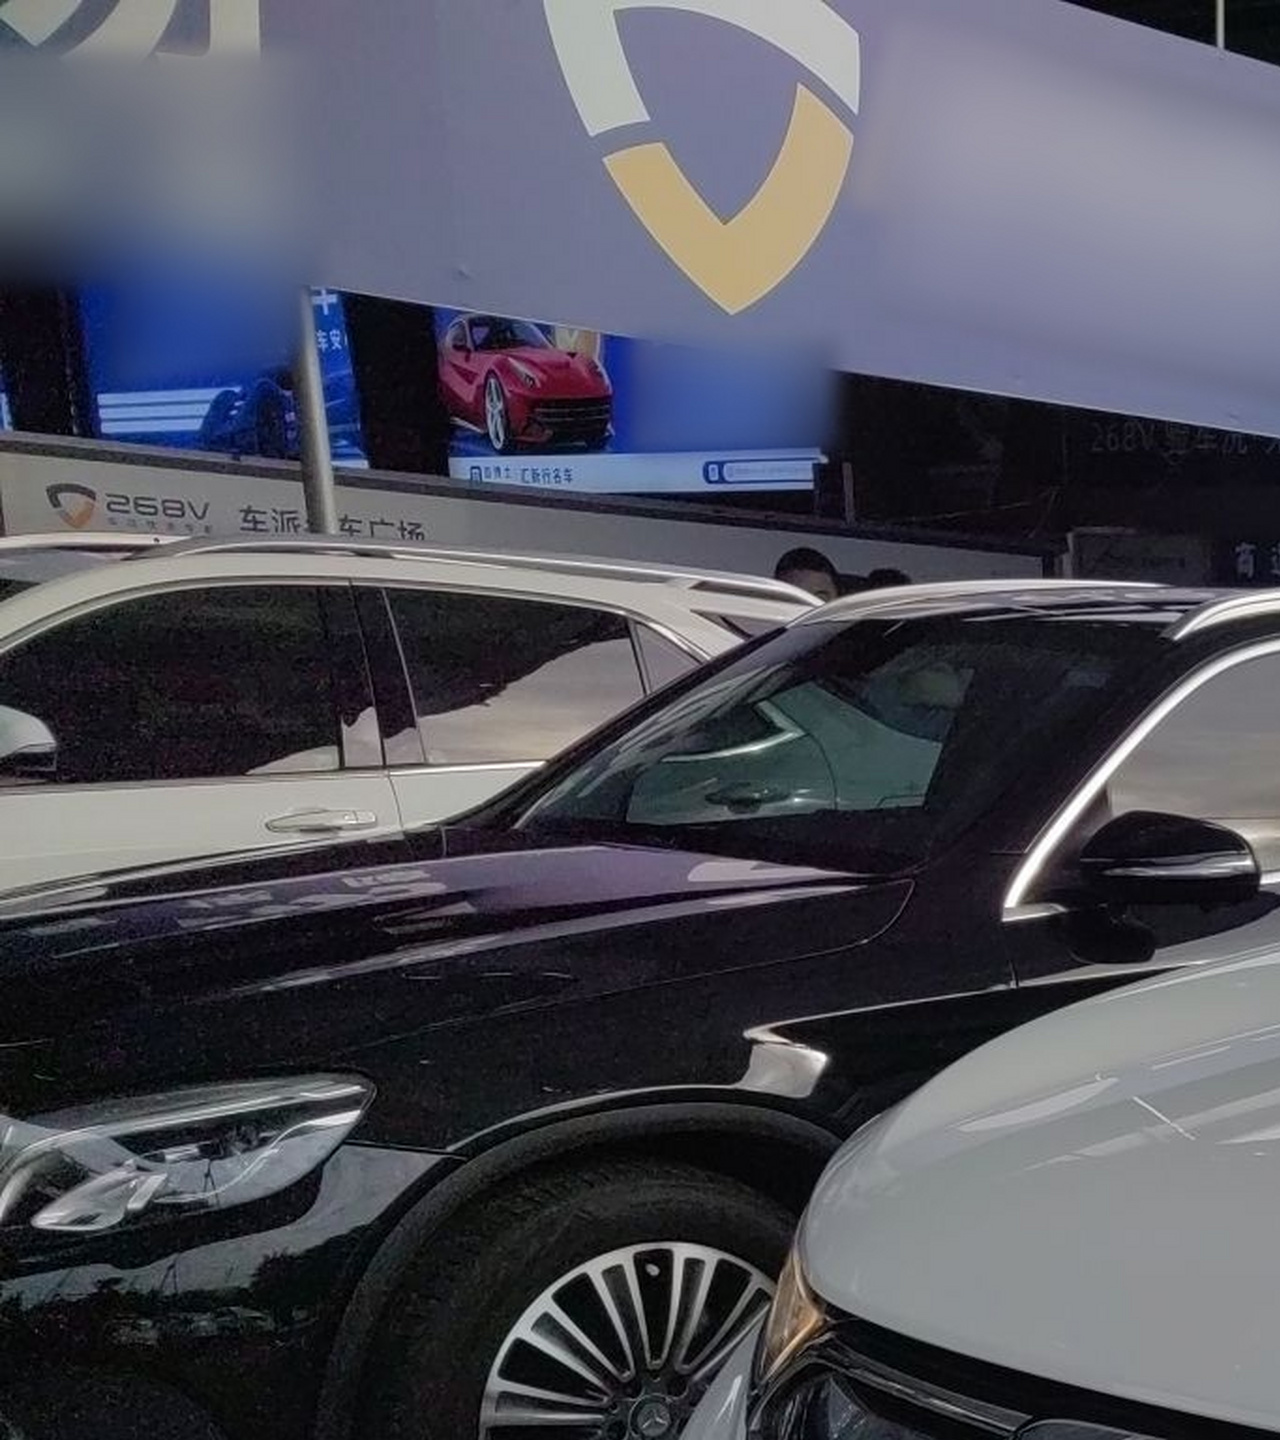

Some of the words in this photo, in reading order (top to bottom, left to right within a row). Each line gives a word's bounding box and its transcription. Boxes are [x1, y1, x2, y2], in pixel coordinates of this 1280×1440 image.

[105, 493, 210, 521] 268V
[238, 505, 426, 541] 车派车广场
